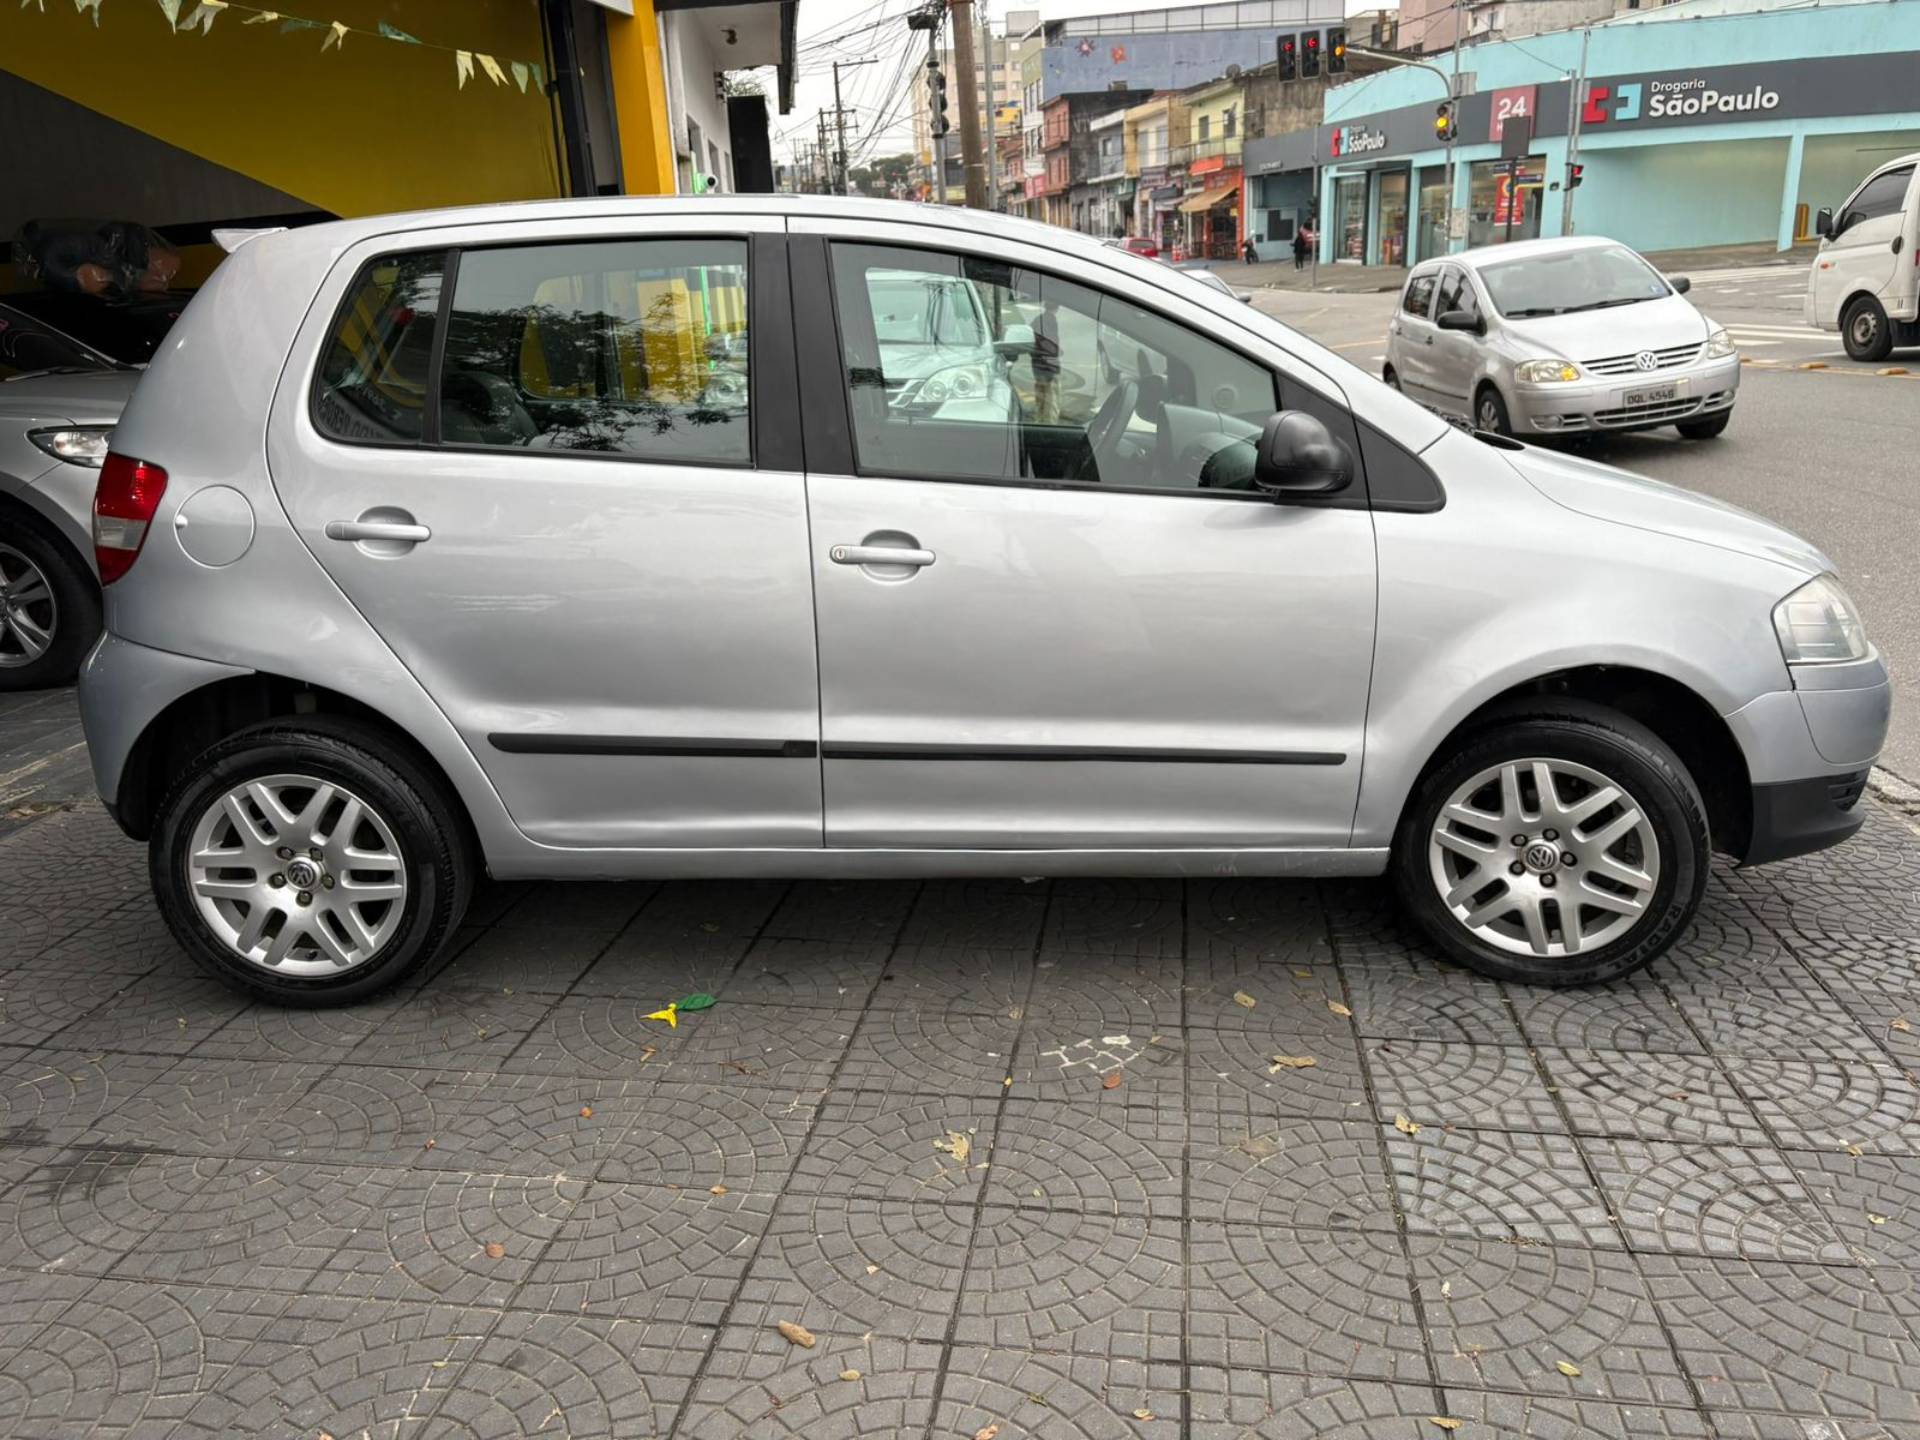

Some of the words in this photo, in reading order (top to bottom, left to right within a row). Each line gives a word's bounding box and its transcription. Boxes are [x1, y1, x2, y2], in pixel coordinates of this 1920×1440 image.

[1651, 79, 1706, 93] Drogaria
[1497, 95, 1527, 120] 24
[1649, 86, 1779, 117] SãoPaulo
[1611, 904, 1683, 970] RADIAL
